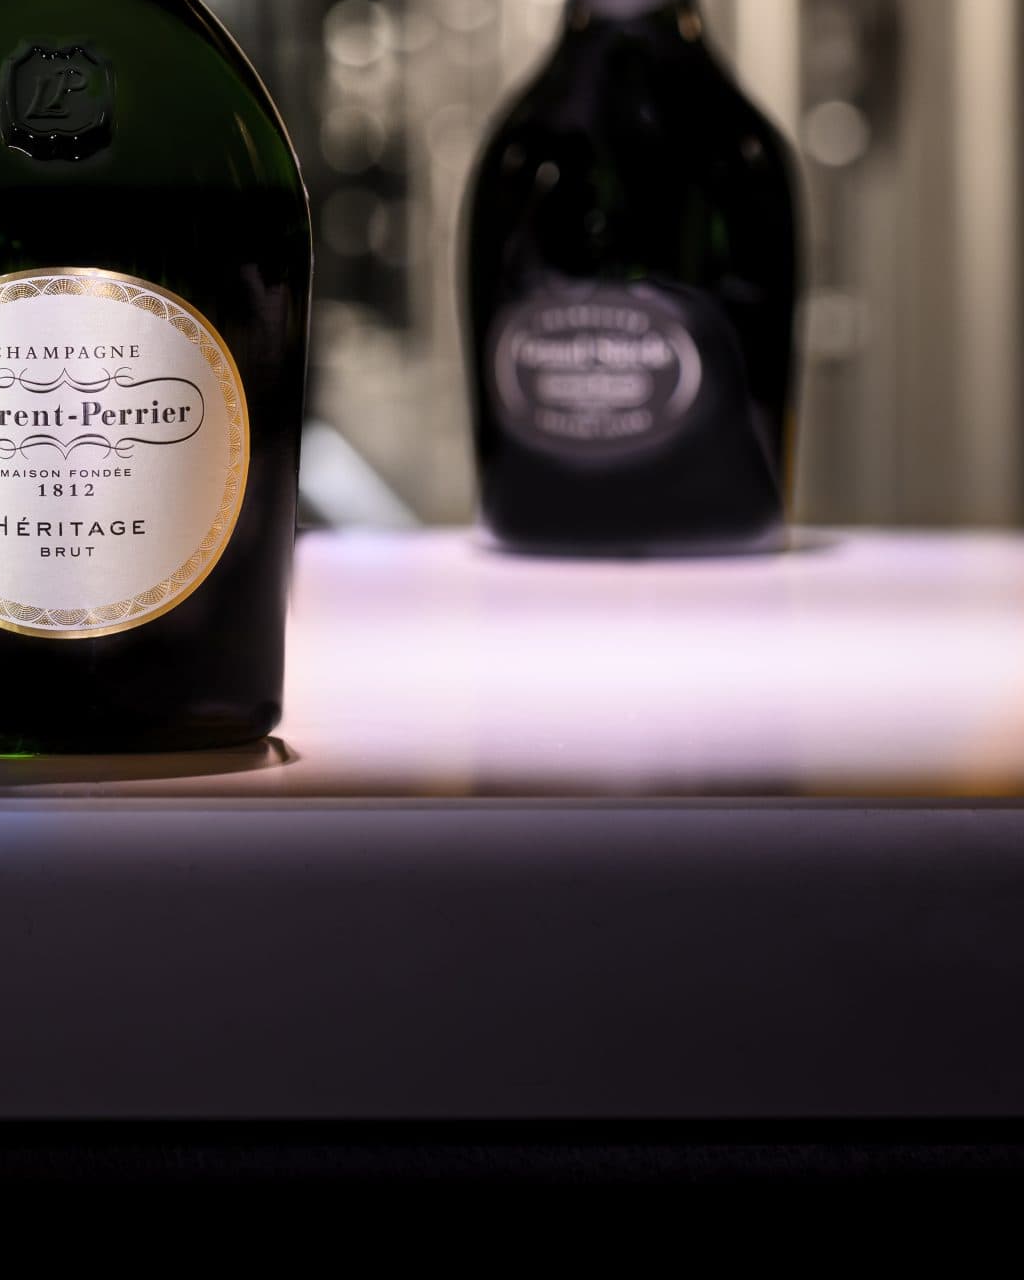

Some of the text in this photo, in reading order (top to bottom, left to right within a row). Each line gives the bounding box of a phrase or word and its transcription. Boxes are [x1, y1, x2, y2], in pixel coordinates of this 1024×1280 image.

[0, 467, 132, 478] MAISON FONDÉE
[38, 483, 95, 497] 1812
[40, 546, 96, 557] BRUT
